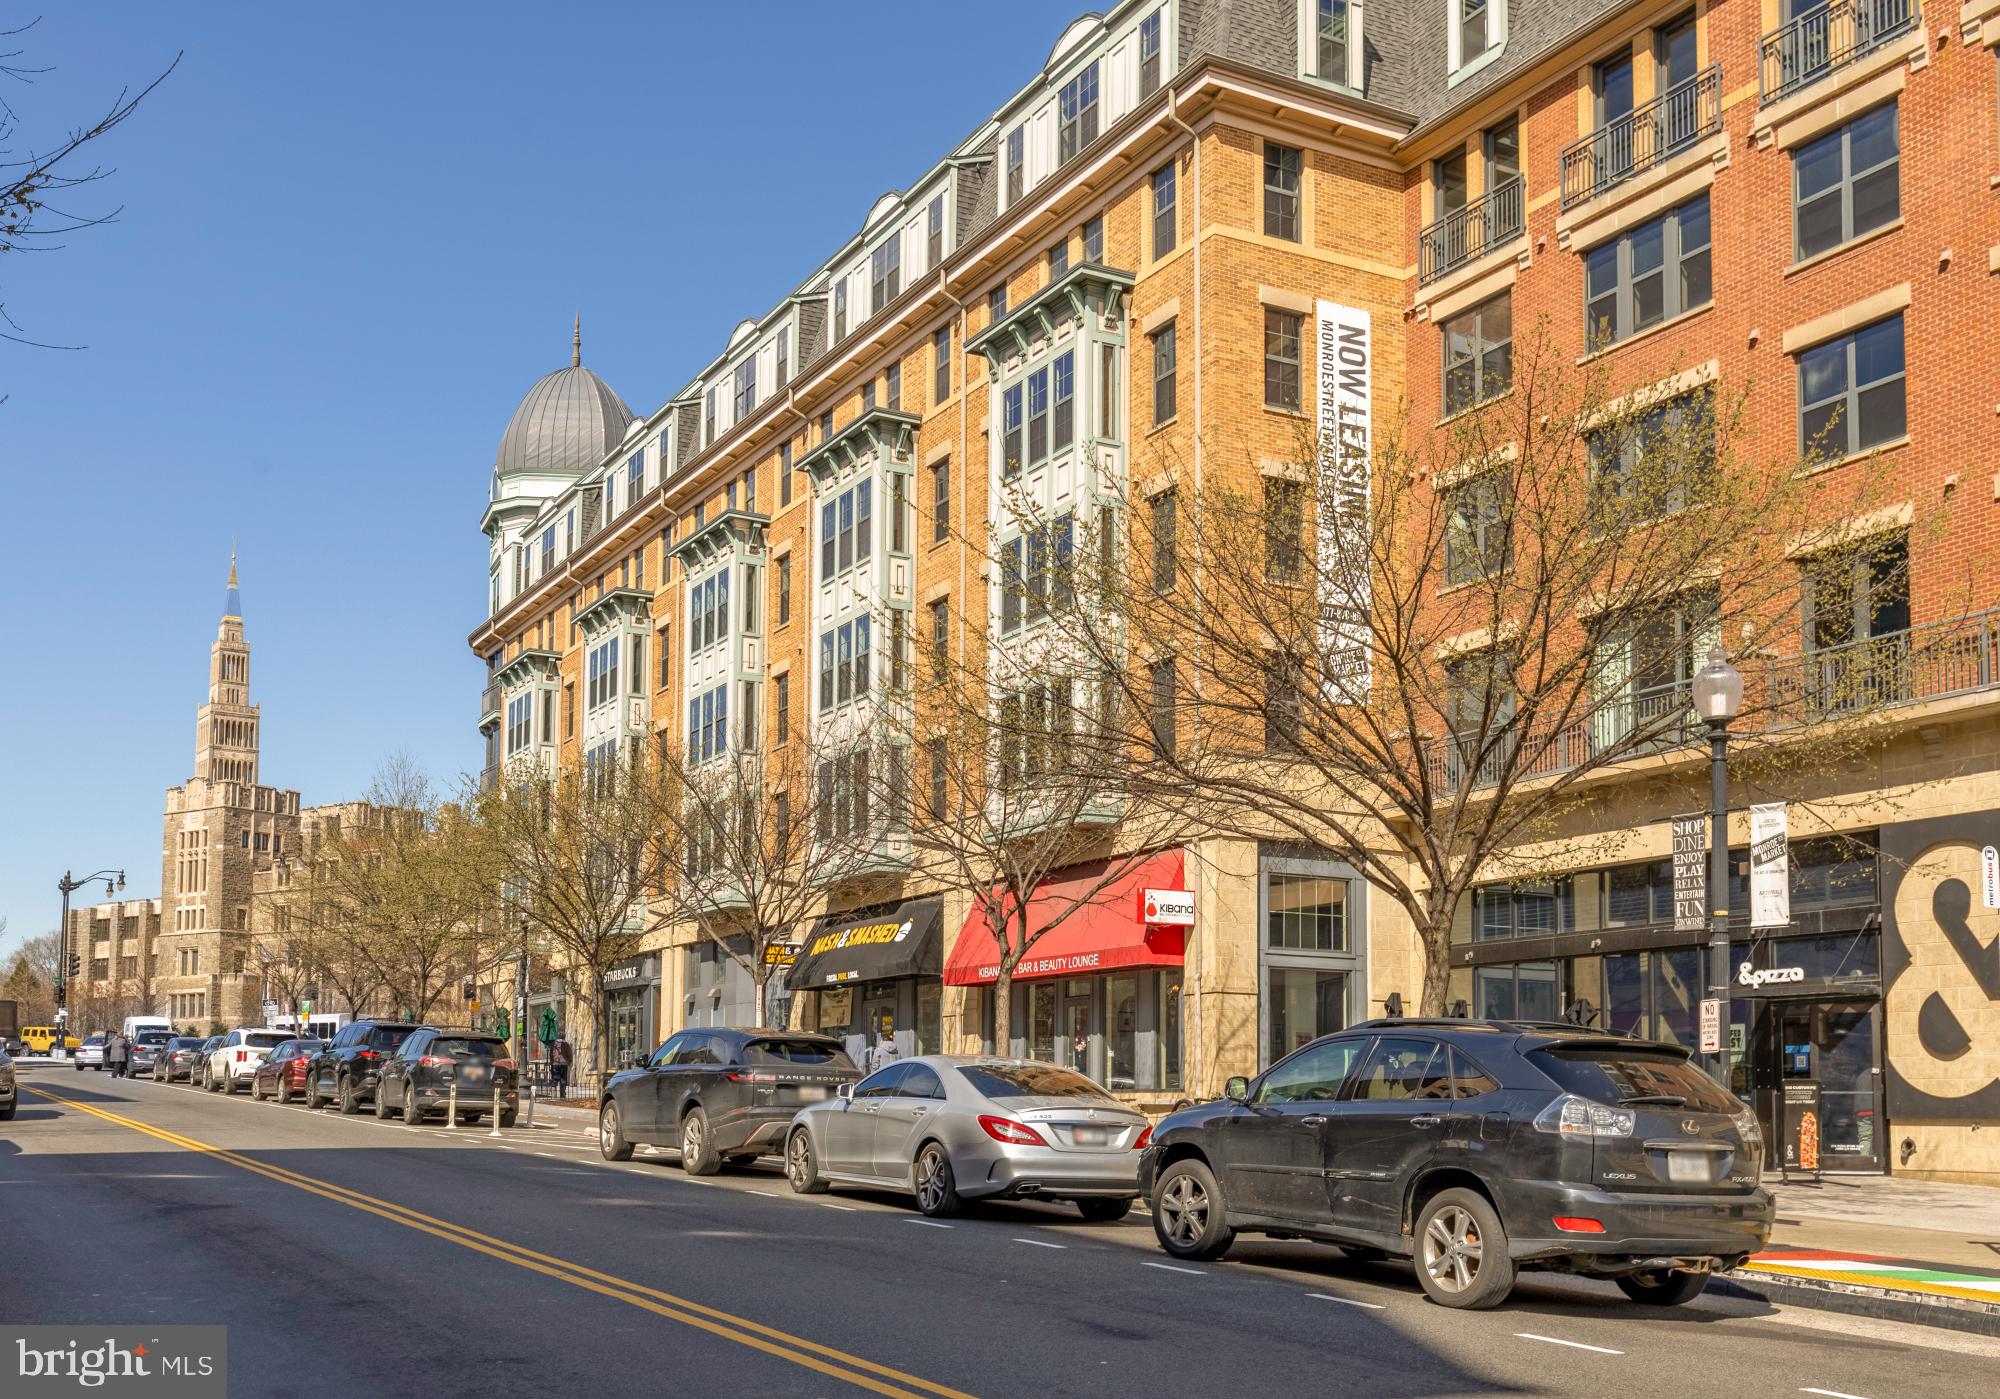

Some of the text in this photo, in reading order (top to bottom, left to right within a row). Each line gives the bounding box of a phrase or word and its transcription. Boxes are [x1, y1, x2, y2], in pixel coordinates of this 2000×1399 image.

[1338, 323, 1367, 399] NOW
[1673, 819, 1704, 836] SHOP
[1674, 835, 1704, 853] DINE
[1752, 839, 1778, 856] MONROE
[1674, 852, 1704, 865] ENJOY
[1760, 844, 1786, 862] MARKET
[1675, 864, 1704, 877] PLAY
[1675, 877, 1704, 889] RELAX
[1675, 889, 1704, 900] ENTERTAIN
[1676, 900, 1704, 917] FUN
[1675, 917, 1705, 926] UNWIND
[1018, 962, 1033, 974] BAR
[1034, 961, 1039, 972] &
[1039, 957, 1068, 972] BEAUTY
[1068, 953, 1099, 969] LOUNGE
[1705, 1004, 1714, 1015] NO
[1603, 1172, 1638, 1180] LEXUS
